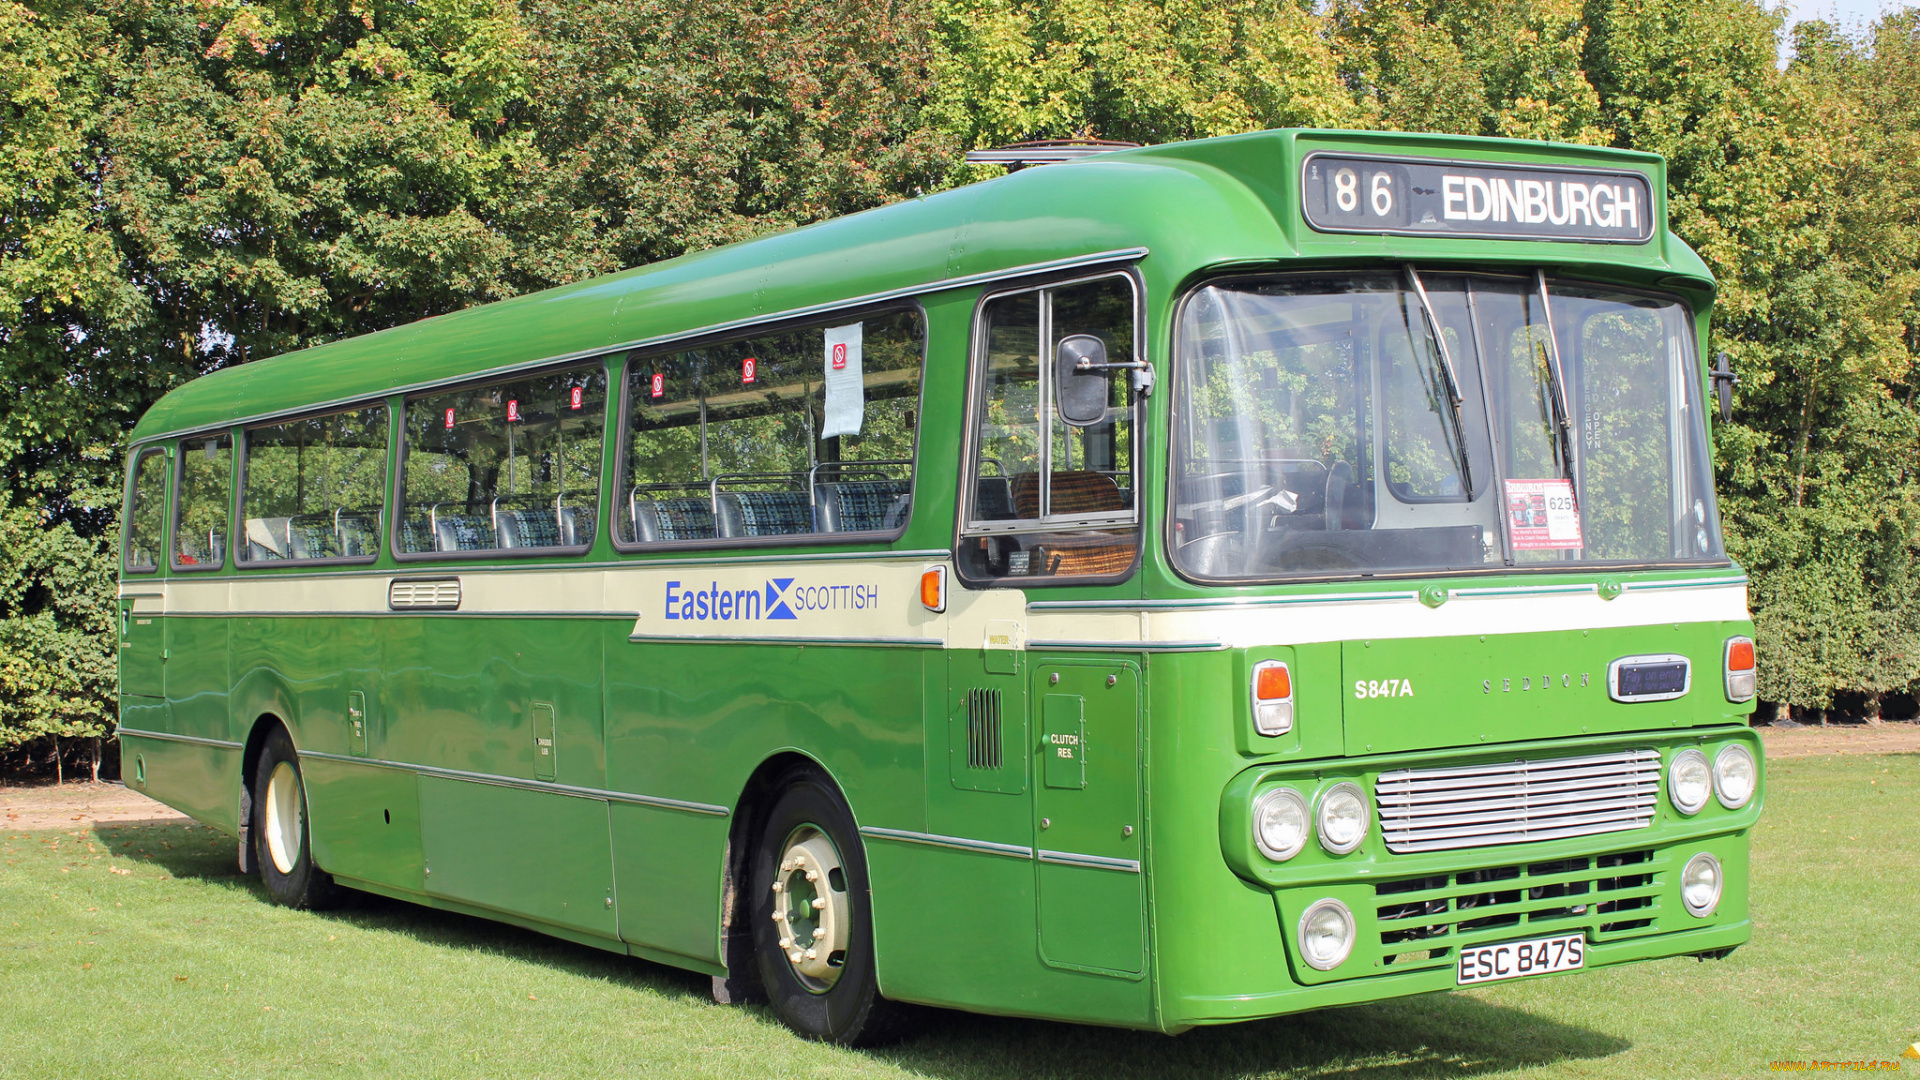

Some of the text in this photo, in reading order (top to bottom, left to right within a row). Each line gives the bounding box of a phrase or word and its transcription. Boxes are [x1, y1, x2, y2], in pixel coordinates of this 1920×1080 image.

[1334, 166, 1638, 229] 86 EDINBURGH
[1593, 411, 1601, 449] OPEN
[1549, 497, 1572, 510] 625
[665, 580, 878, 620] Eastern SCOTTISH
[989, 635, 1009, 645] WATER
[1354, 672, 1590, 699] S847A SEDDON
[1625, 668, 1683, 684] Pay on entry
[1051, 733, 1079, 745] CLUTCH
[1057, 747, 1074, 759] RES.
[1460, 937, 1582, 981] ESC 847S
